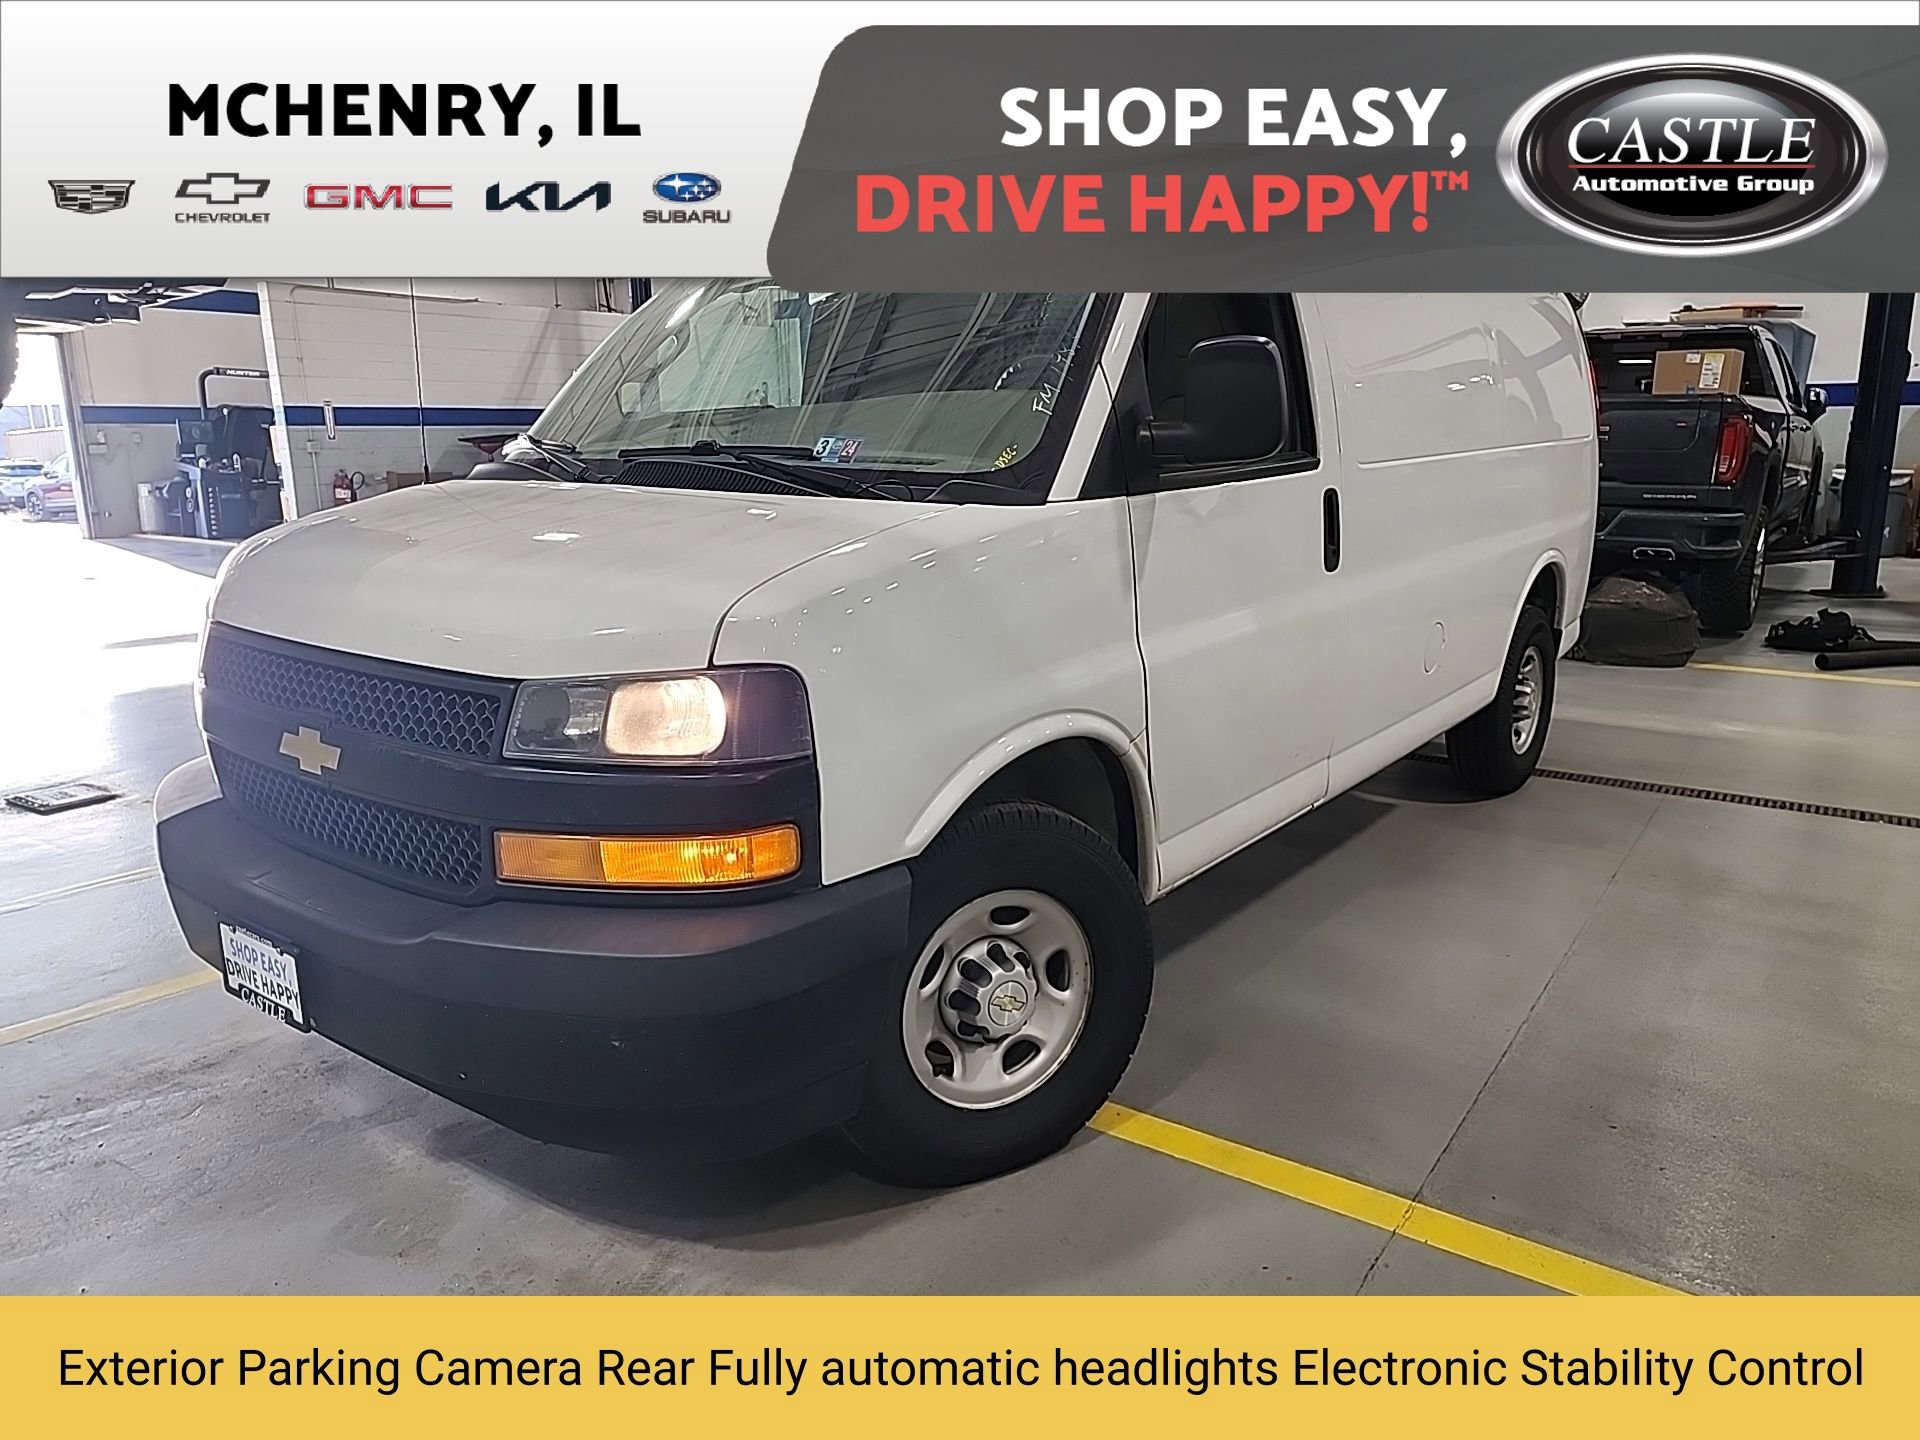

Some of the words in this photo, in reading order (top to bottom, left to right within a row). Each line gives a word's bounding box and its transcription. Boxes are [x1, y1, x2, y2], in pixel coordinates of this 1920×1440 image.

[226, 369, 261, 377] HUNTER
[816, 439, 830, 456] 3
[840, 440, 858, 456] 24
[229, 938, 258, 967] SHOP
[226, 957, 260, 990] DRIVE
[260, 974, 300, 1009] HAPPY
[241, 987, 287, 1022] CASTLE
